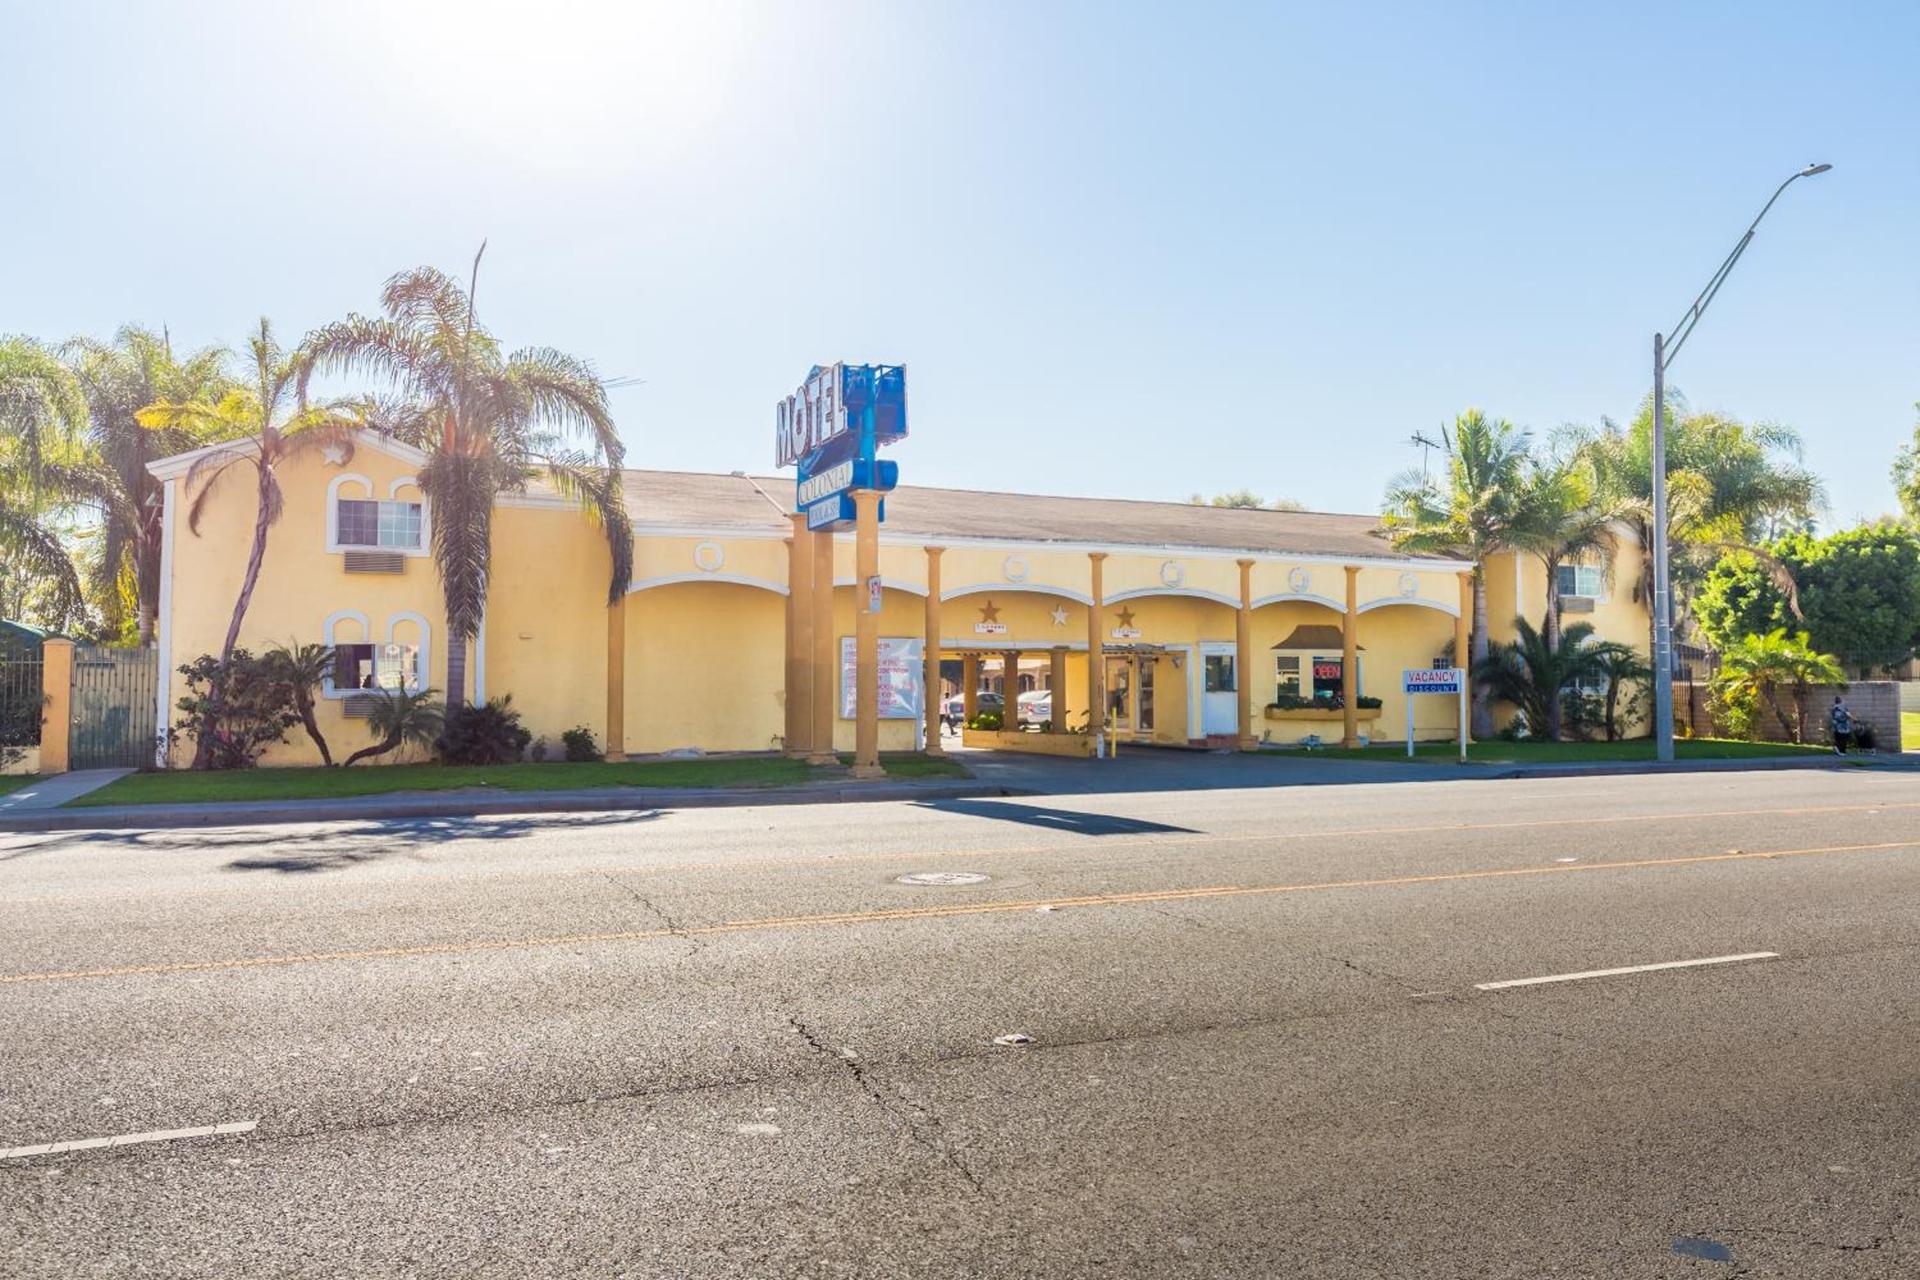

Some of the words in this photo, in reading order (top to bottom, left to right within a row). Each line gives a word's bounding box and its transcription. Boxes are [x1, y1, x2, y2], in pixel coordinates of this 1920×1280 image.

[776, 360, 848, 468] MOTEL
[1313, 664, 1340, 679] OPEN
[1408, 671, 1455, 682] VACANCY
